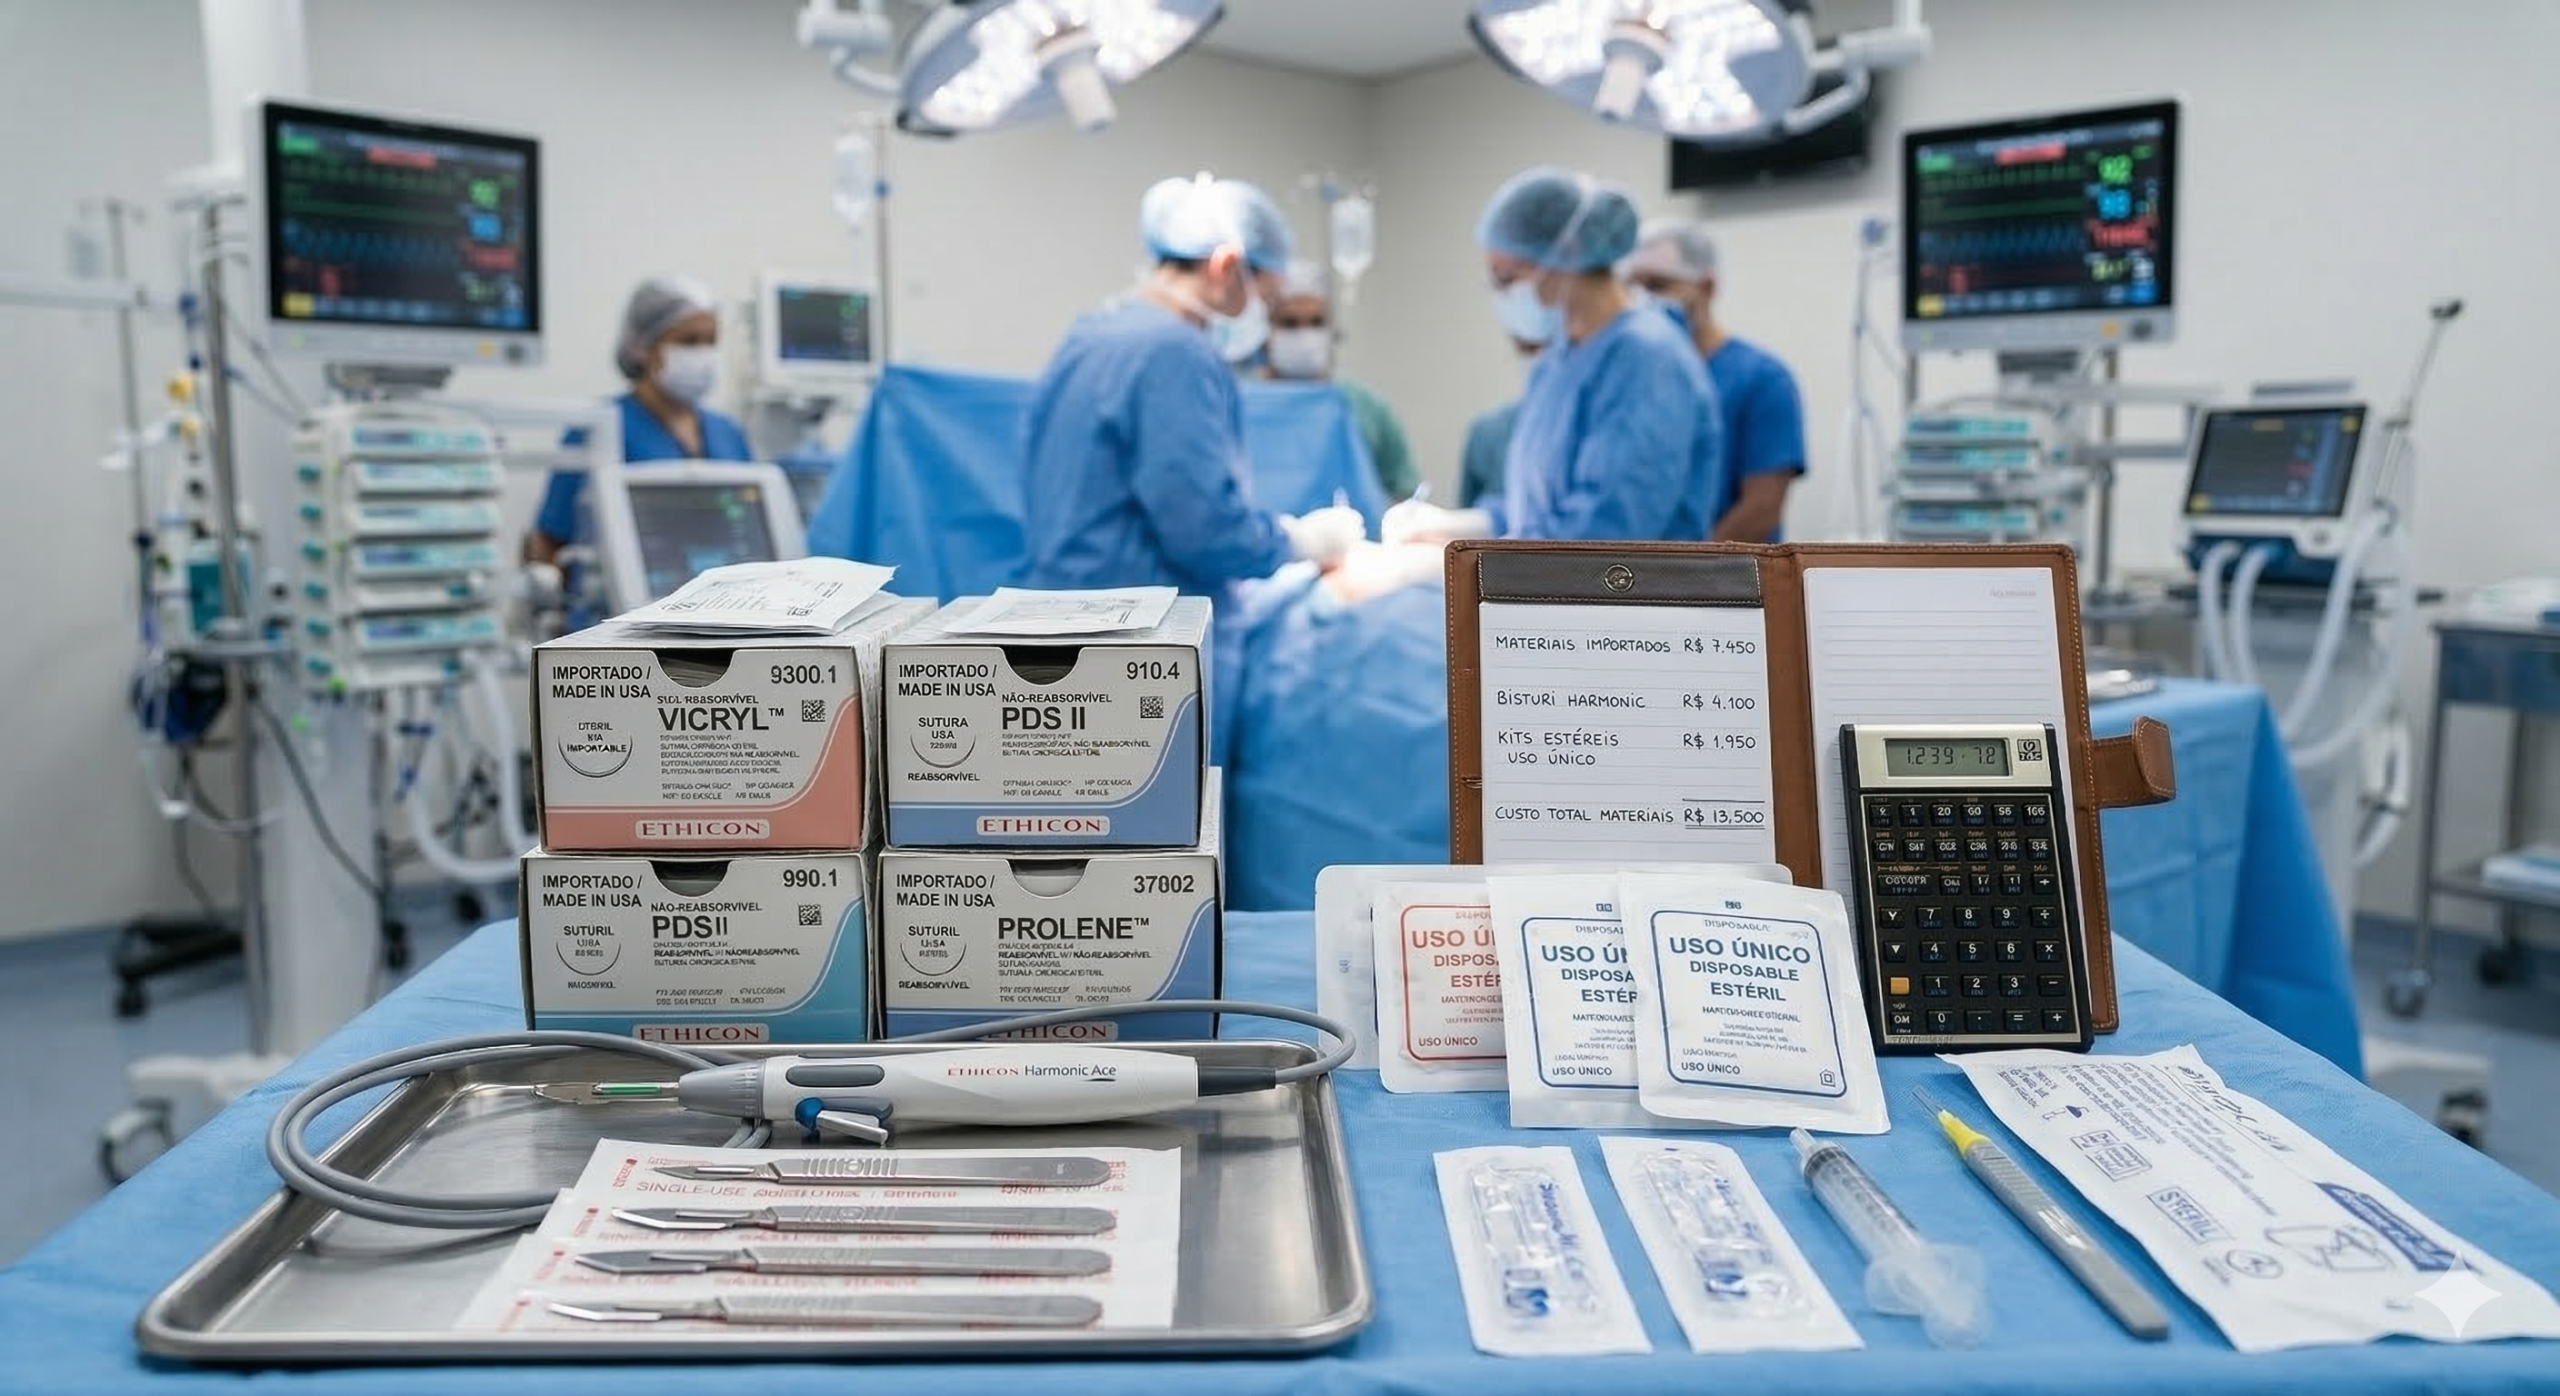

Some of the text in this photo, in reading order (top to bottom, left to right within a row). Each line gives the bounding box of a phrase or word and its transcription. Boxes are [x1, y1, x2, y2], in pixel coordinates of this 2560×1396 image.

[1495, 635, 1576, 651] MATERIAIS
[1683, 637, 1704, 654] R$
[1712, 638, 1756, 654] 7.450
[552, 665, 652, 680] IMPORTADO /
[770, 664, 837, 685] 9300.1
[899, 664, 998, 678] IMPORTADO /
[1126, 661, 1181, 680] 910.4
[552, 684, 651, 699] MADE IN USA
[898, 683, 997, 697] MADE IN USA
[1567, 692, 1647, 709] HARMONIC
[1682, 692, 1704, 711] R$
[1711, 696, 1756, 710] 4.100
[918, 717, 969, 728] SUTURA
[1002, 706, 1086, 731] PDS II
[931, 730, 955, 739] USA
[1498, 727, 1533, 745] KITS
[1682, 731, 1705, 750] R$
[1507, 748, 1596, 766] USO ÚNICO
[1494, 806, 1765, 826] CUSTO TOTAL MATERIAIS R$ 13,500
[641, 821, 761, 836] ETHICON
[982, 818, 1102, 833] ETHICON
[542, 874, 643, 889] IMPORTADO /
[782, 868, 838, 888] 990.1
[896, 874, 996, 889] IMPORTADO /
[542, 893, 642, 908] MADE IN USA
[896, 893, 996, 908] MADE IN USA
[1926, 908, 1935, 919] 7
[1965, 908, 1973, 919] 8
[2002, 908, 2011, 919] 9
[563, 925, 615, 936] SUTURIL
[908, 926, 961, 937] SUTURIL
[1411, 929, 1466, 949] USO
[1541, 945, 1595, 963] USO
[1669, 936, 1811, 964] USO ÚNICO
[1930, 943, 1939, 954] 4
[1968, 943, 1977, 954] 5
[2006, 943, 2016, 954] 6
[1689, 960, 1800, 982] DISPOSABLE
[1934, 977, 2019, 988] 1 2 3
[1710, 982, 1787, 1002] ESTÉRIL
[640, 1026, 760, 1041] ETHICON
[1418, 1037, 1442, 1047] USO
[947, 1064, 1117, 1077] ETHICON Harmonic Ace
[1552, 1067, 1576, 1076] USO
[1681, 1061, 1705, 1072] USO
[635, 1181, 748, 1197] SINGLE-USE
